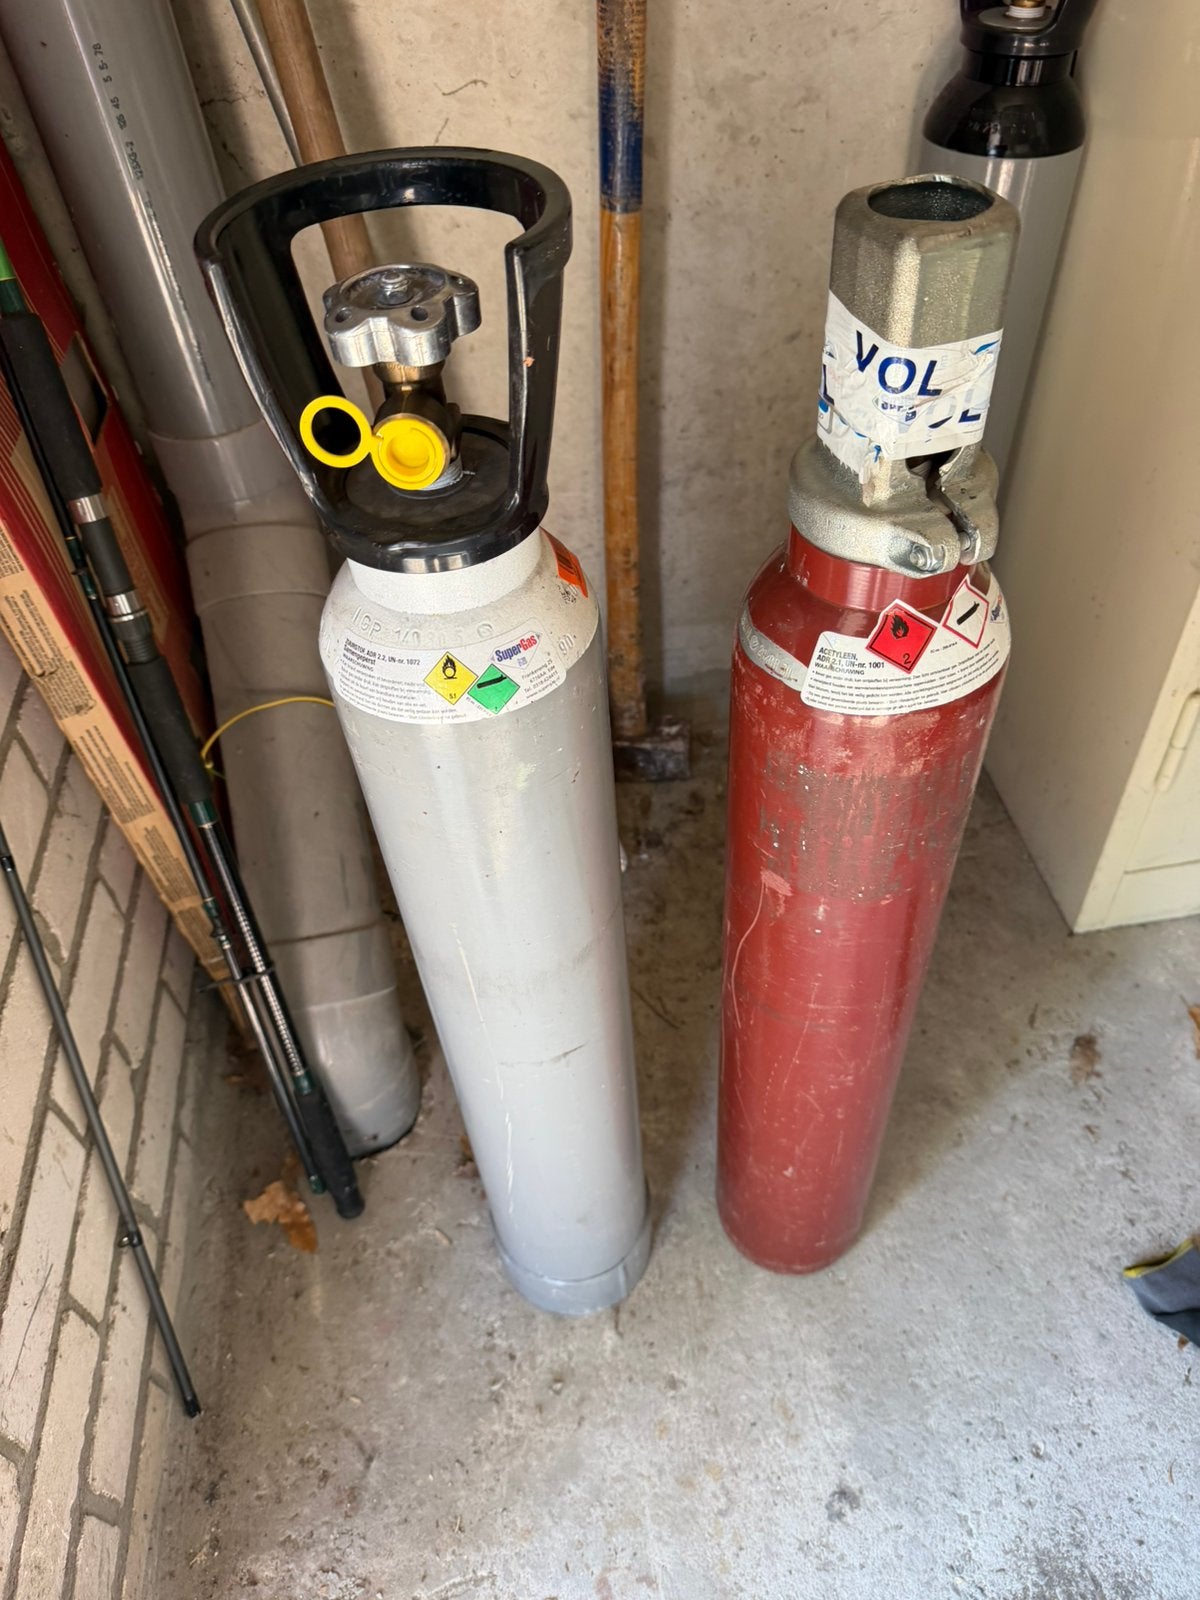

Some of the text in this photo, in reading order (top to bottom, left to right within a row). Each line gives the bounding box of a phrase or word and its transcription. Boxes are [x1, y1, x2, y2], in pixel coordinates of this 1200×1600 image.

[856, 330, 943, 396] VOL
[495, 635, 538, 662] SuperGas
[819, 647, 858, 661] ACETYLEEN,
[407, 658, 421, 666] 1072
[816, 654, 830, 664] ADR
[903, 653, 912, 665] 2
